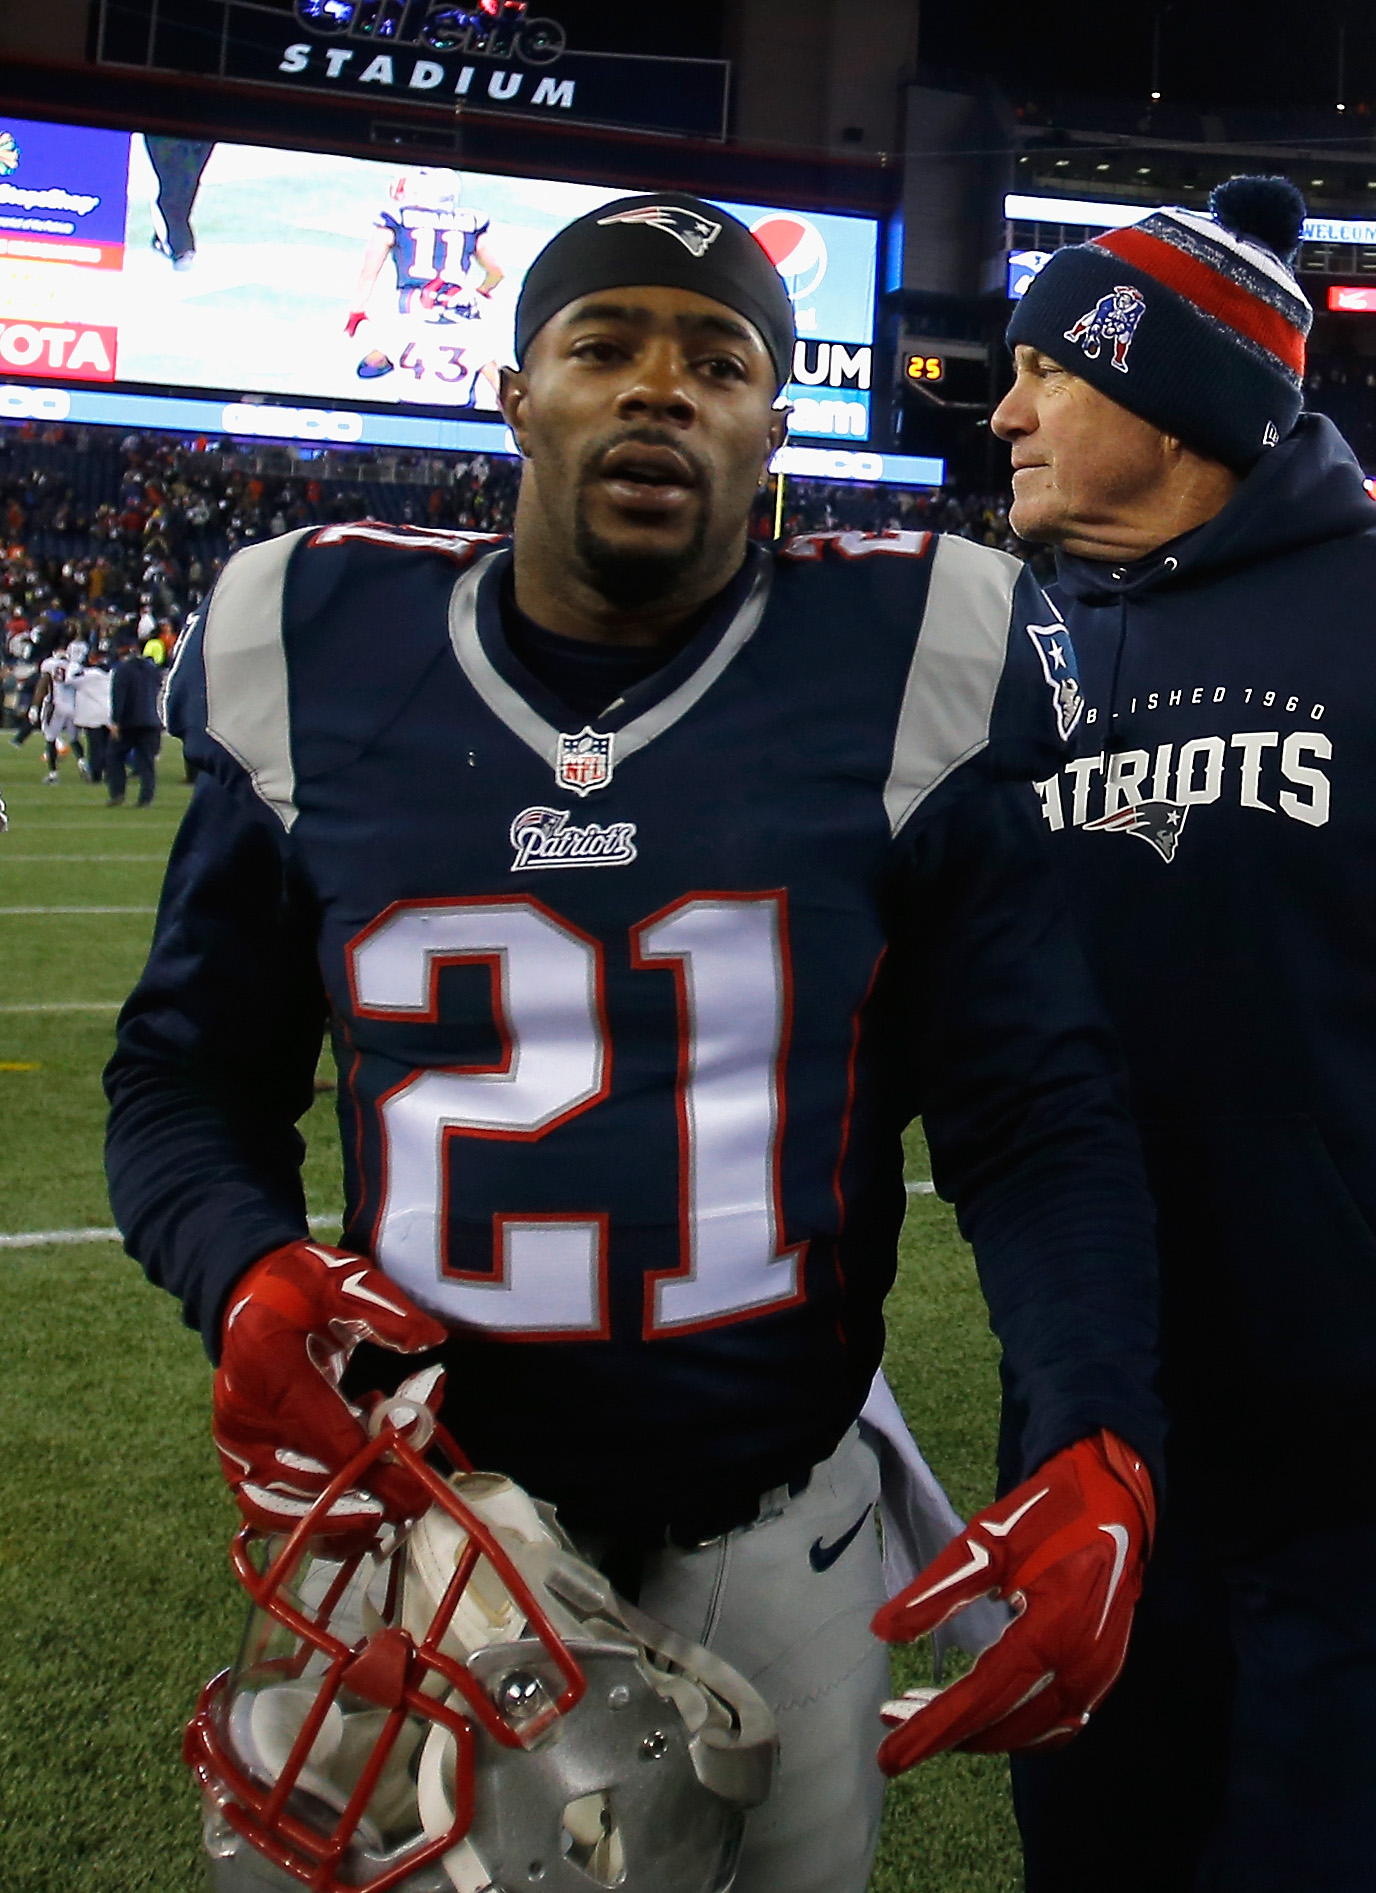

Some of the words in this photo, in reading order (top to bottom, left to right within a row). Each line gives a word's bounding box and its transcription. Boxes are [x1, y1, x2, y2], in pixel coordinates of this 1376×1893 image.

[278, 43, 577, 108] STADIUM
[407, 227, 467, 282] 11
[0, 323, 111, 373] OTA
[399, 342, 468, 383] 43
[793, 340, 872, 390] UM
[908, 356, 941, 380] 25
[1243, 687, 1325, 721] 1960
[564, 756, 606, 783] NFL
[512, 818, 637, 872] Patriots
[345, 888, 809, 1341] 21
